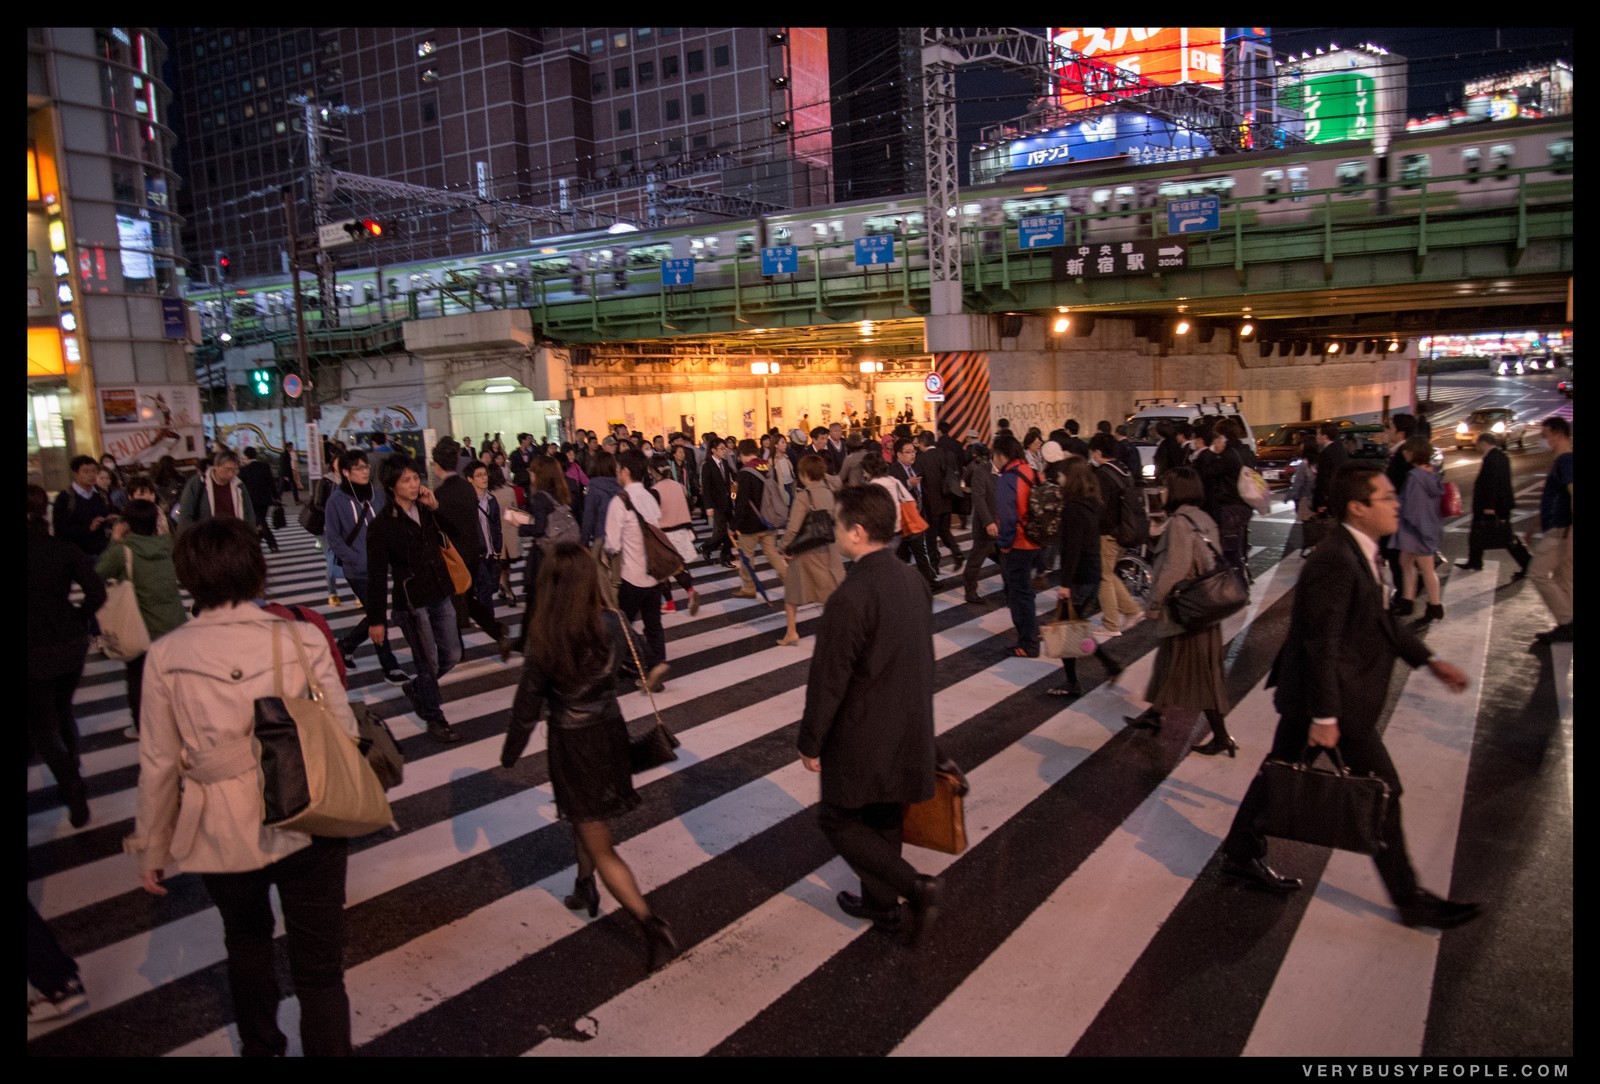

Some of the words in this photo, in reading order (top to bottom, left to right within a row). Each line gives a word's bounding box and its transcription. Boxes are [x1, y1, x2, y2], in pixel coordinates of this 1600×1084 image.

[1027, 144, 1069, 166] パチンコ
[1171, 201, 1200, 212] 新宿駅
[1021, 217, 1048, 228] 新宿駅
[1078, 243, 1133, 257] 中央線
[1066, 253, 1145, 276] 新宿駅
[1158, 258, 1183, 267] 300M
